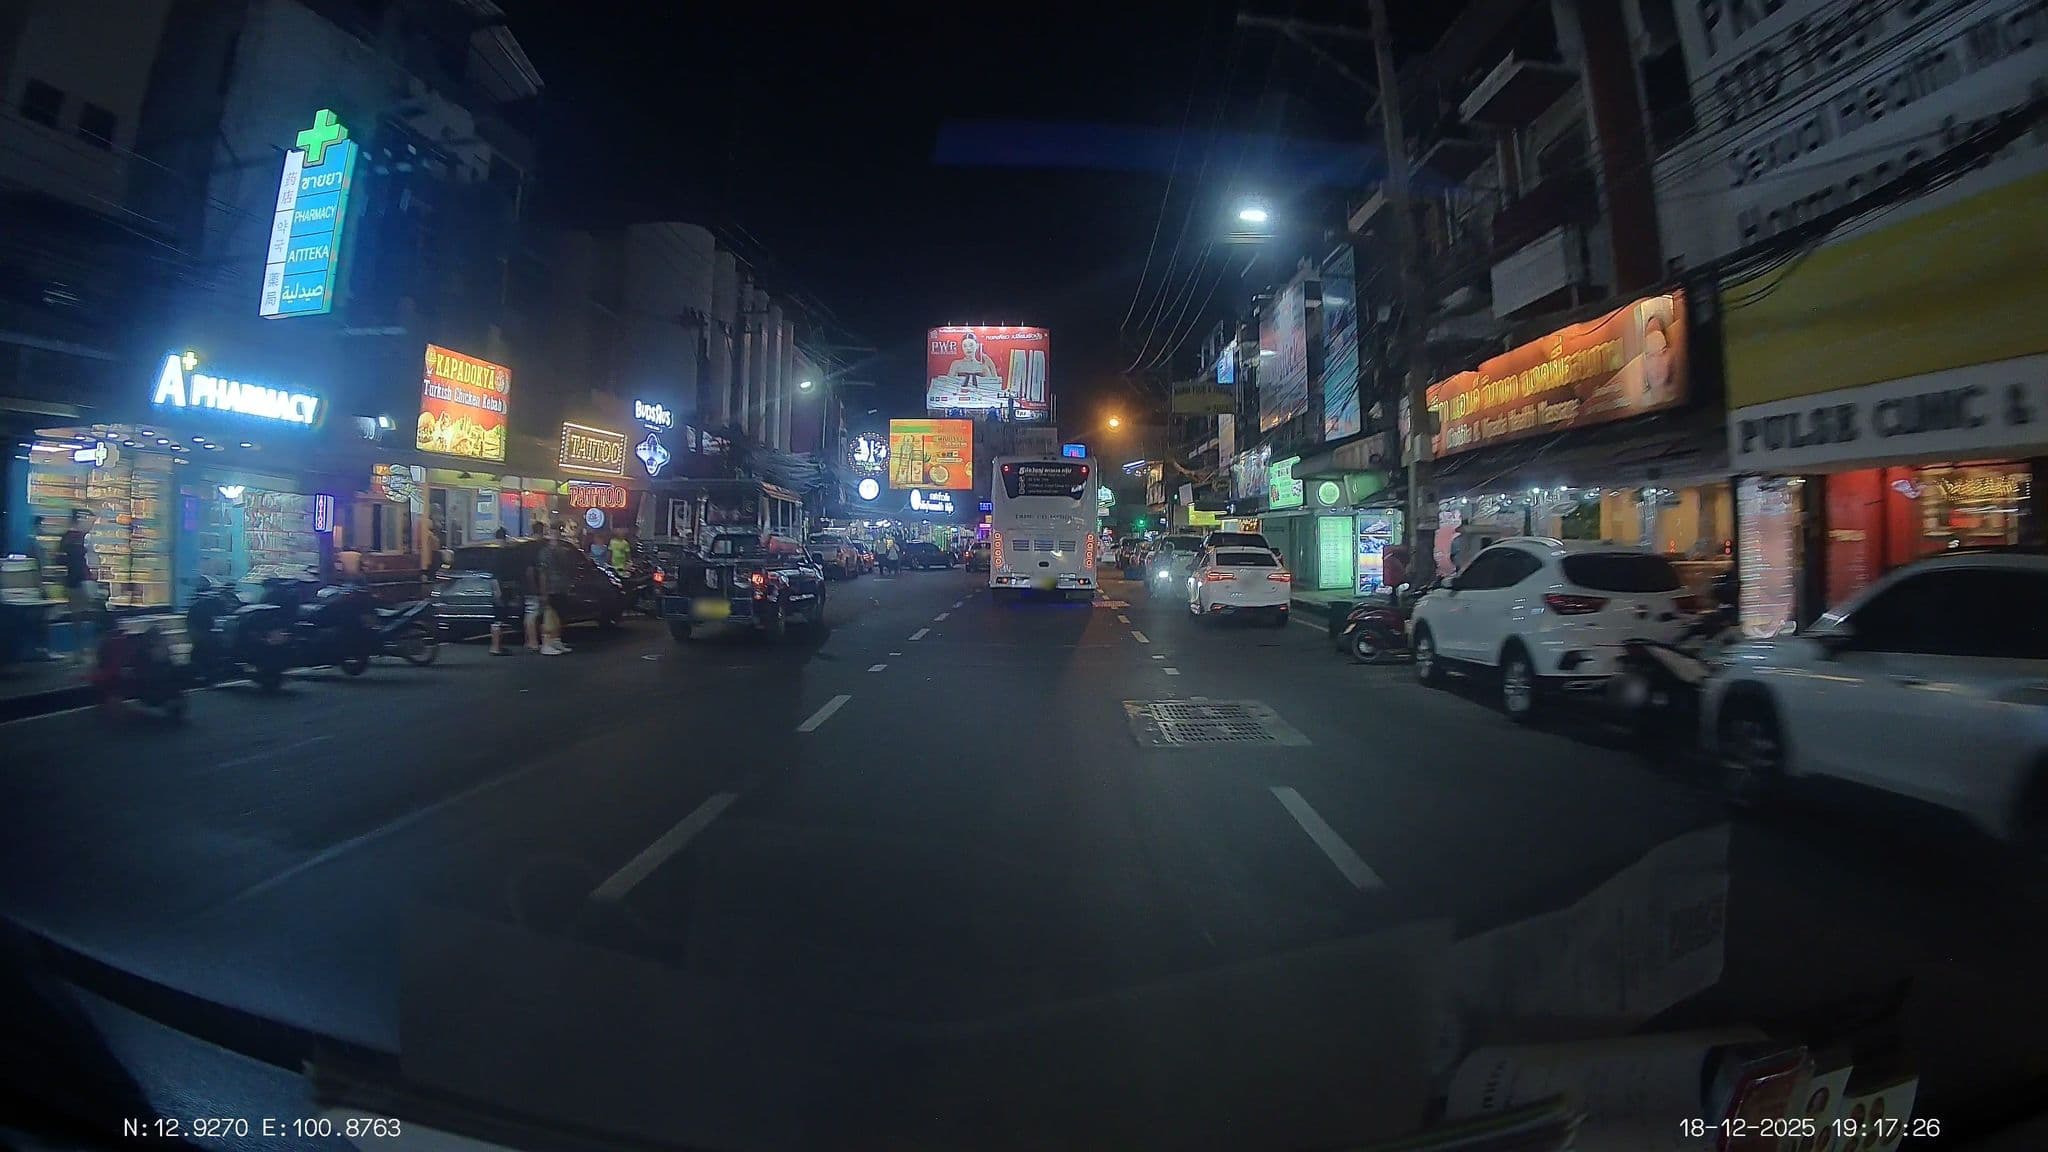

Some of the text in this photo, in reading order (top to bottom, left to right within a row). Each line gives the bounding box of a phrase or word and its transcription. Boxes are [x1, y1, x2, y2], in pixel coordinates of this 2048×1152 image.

[301, 170, 342, 190] ขายยา
[295, 205, 336, 224] PHARMACY
[288, 245, 329, 263] АПТЕКА
[281, 282, 323, 305] صيدلية
[190, 373, 321, 424] PHARMACY
[423, 378, 503, 412] Turkish Chicken Kebab
[570, 434, 621, 464] TATTOO
[569, 486, 627, 508] TATTOO
